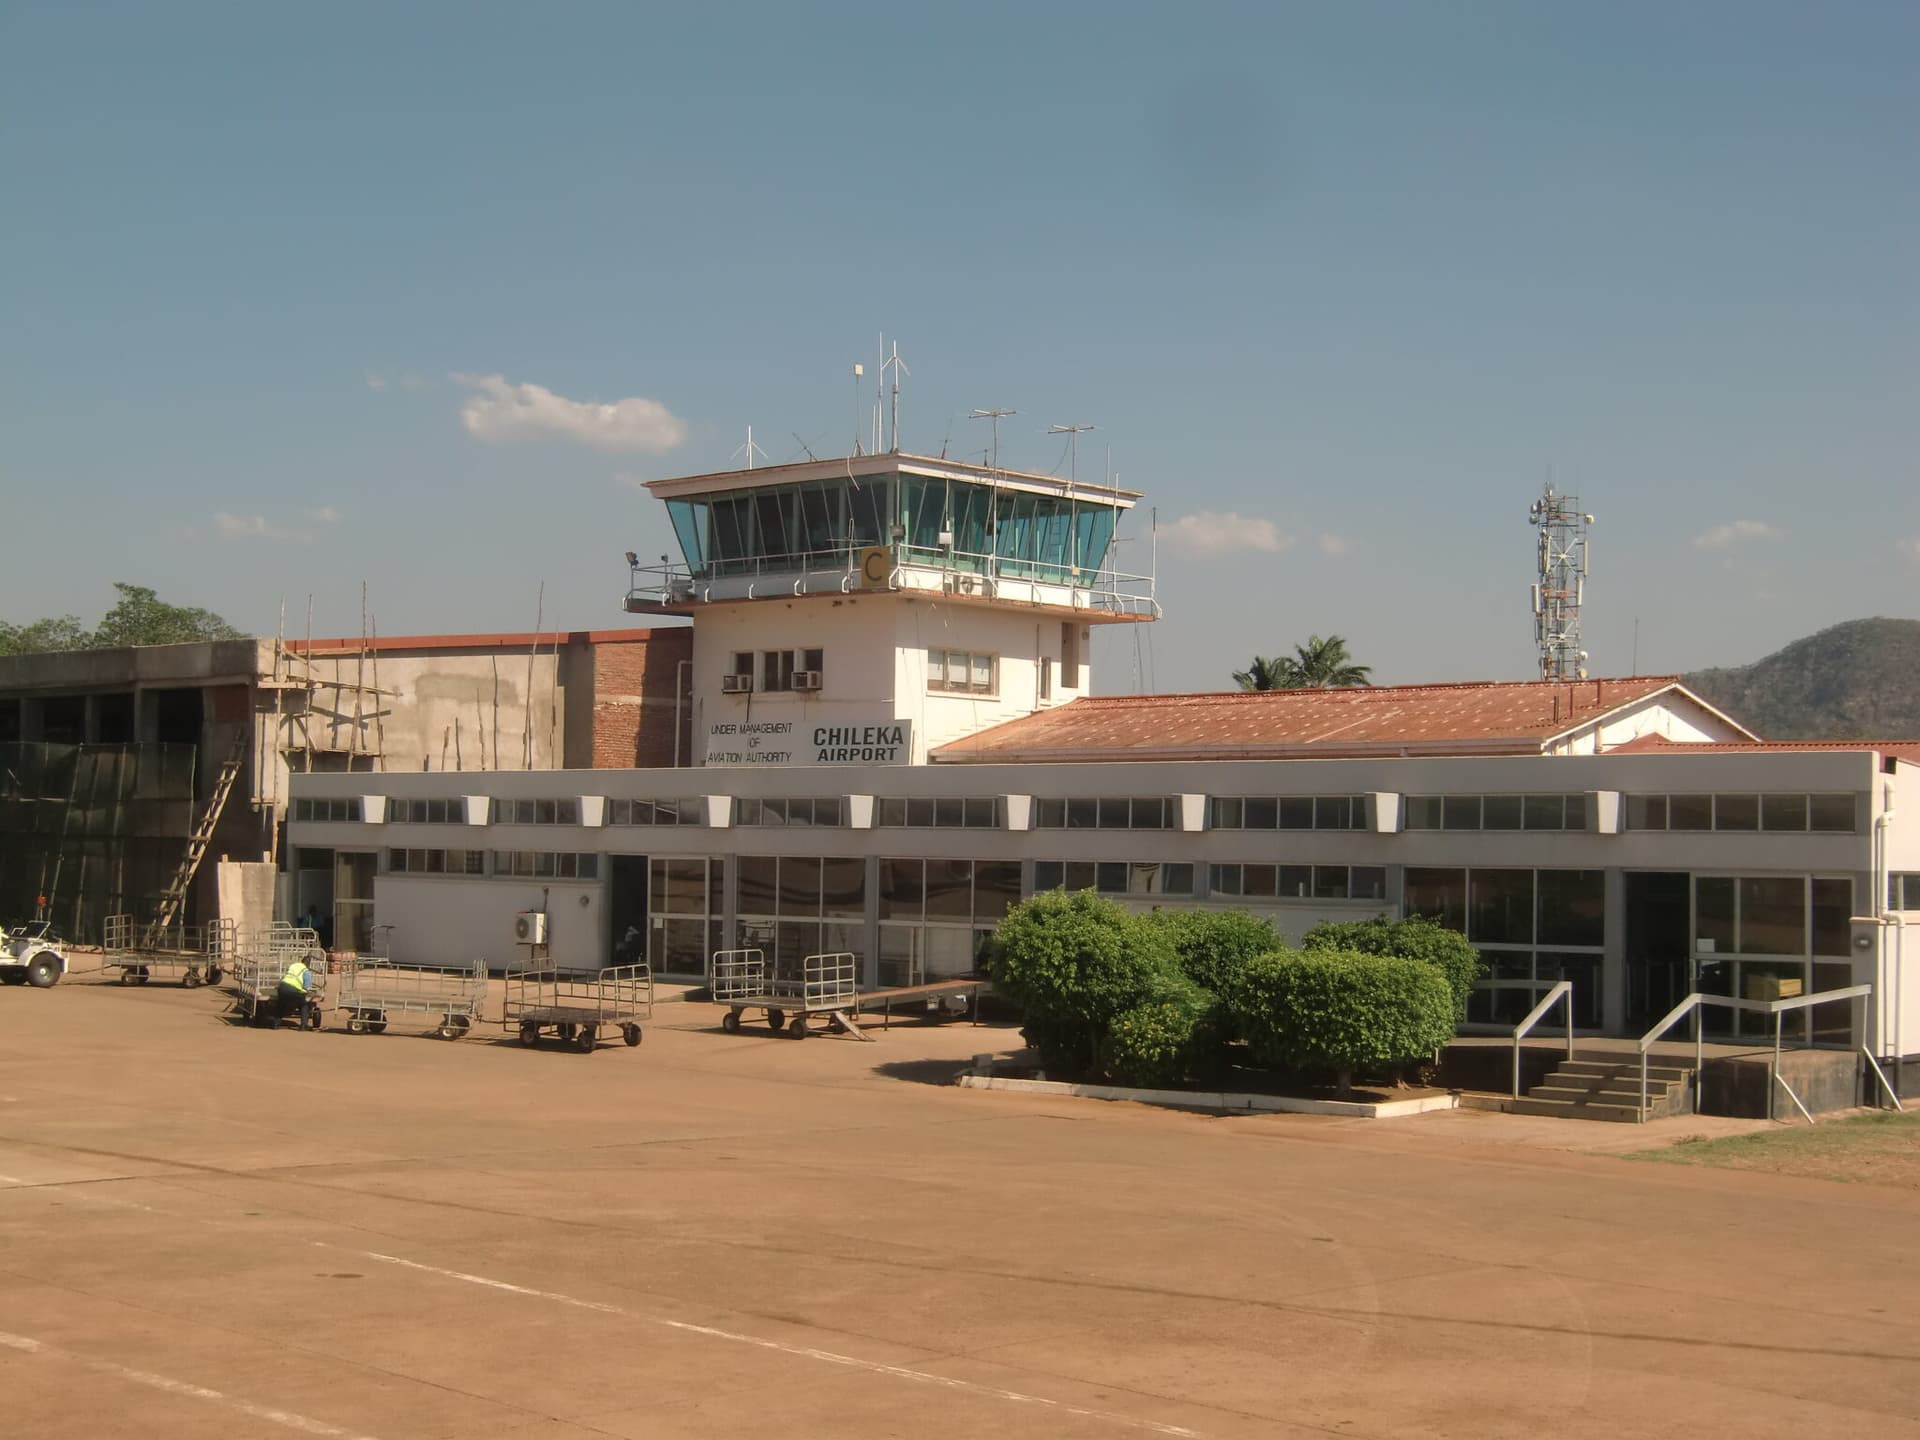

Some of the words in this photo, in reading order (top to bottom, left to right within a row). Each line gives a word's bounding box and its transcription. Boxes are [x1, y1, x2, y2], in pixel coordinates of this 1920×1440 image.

[864, 551, 883, 581] C
[711, 724, 737, 735] UNDER
[739, 722, 793, 735] MANAGEMENT
[749, 737, 761, 748] OF
[813, 726, 904, 746] CHILEKA
[707, 752, 742, 763] AVIATION
[746, 751, 792, 763] AUTHORITY
[817, 747, 898, 762] AIRPORT
